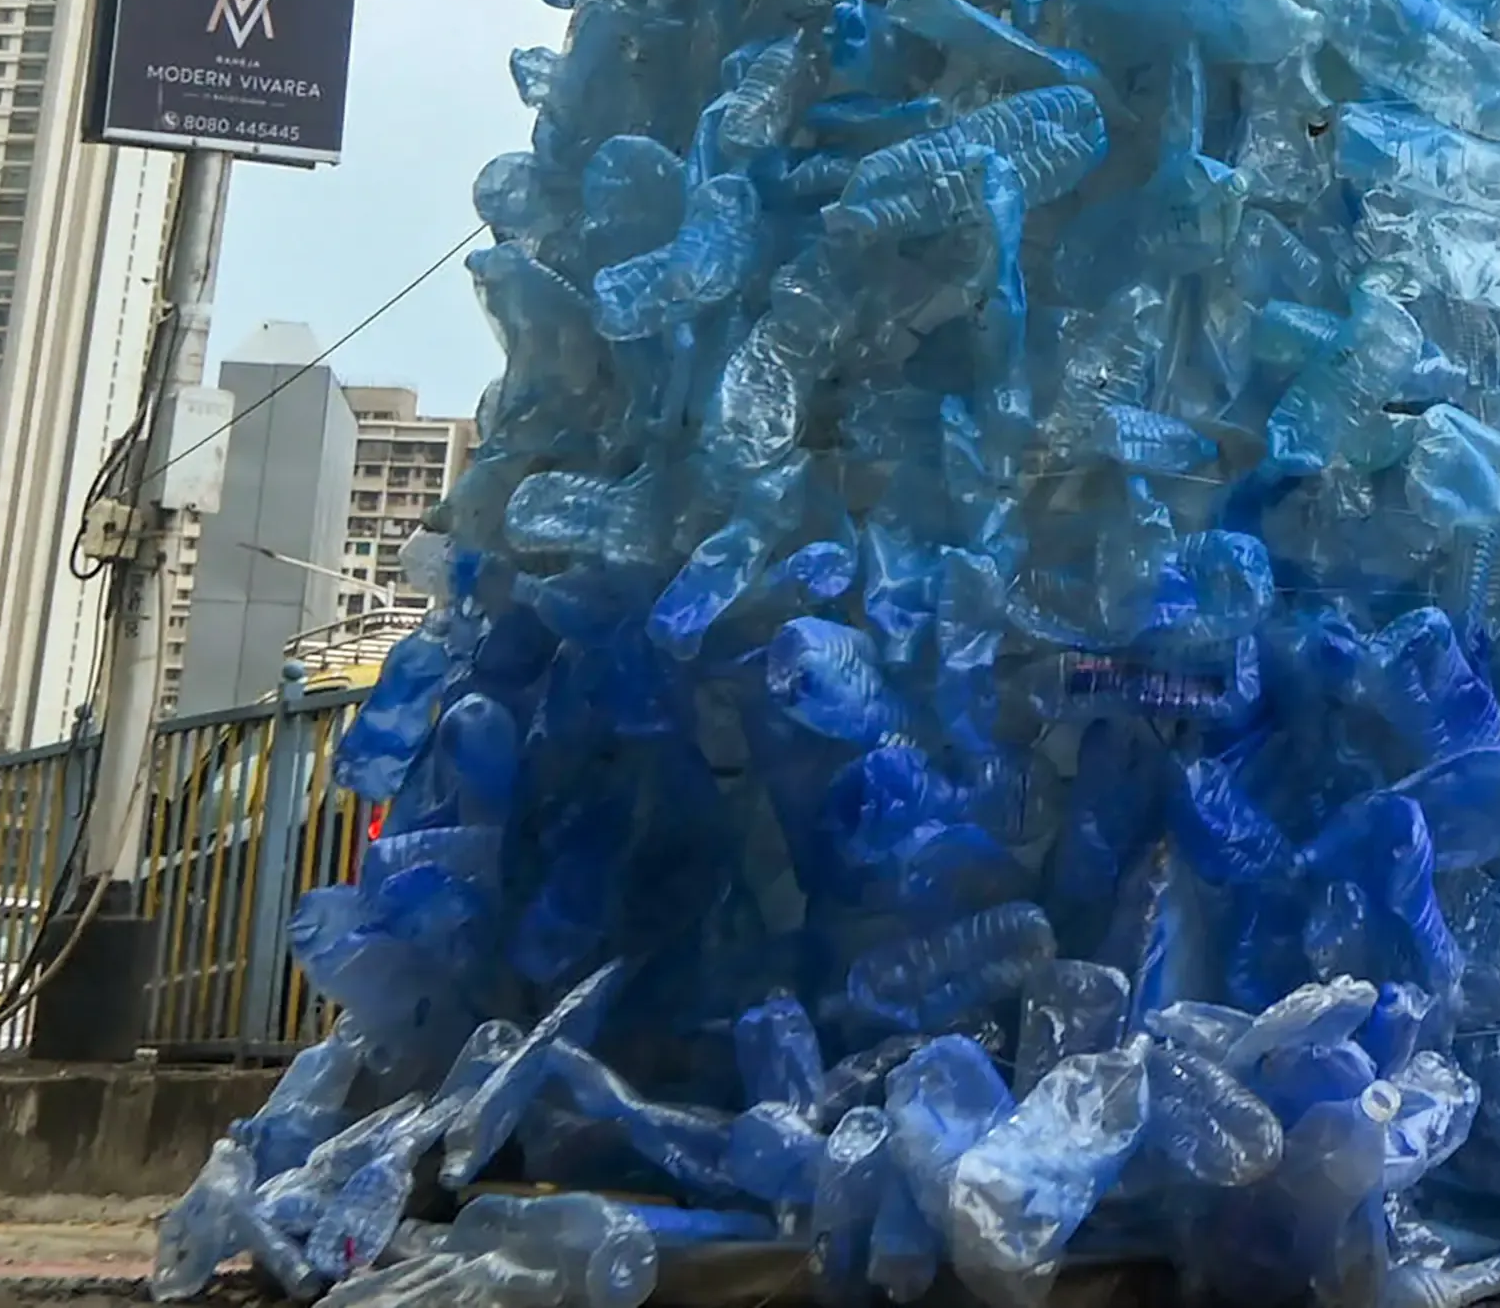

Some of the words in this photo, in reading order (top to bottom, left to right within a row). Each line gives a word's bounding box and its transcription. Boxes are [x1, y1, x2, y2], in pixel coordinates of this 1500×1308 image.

[147, 65, 232, 87] MODERN
[239, 75, 322, 99] VIVAREA
[183, 115, 230, 134] 8080
[235, 120, 301, 142] 445445
